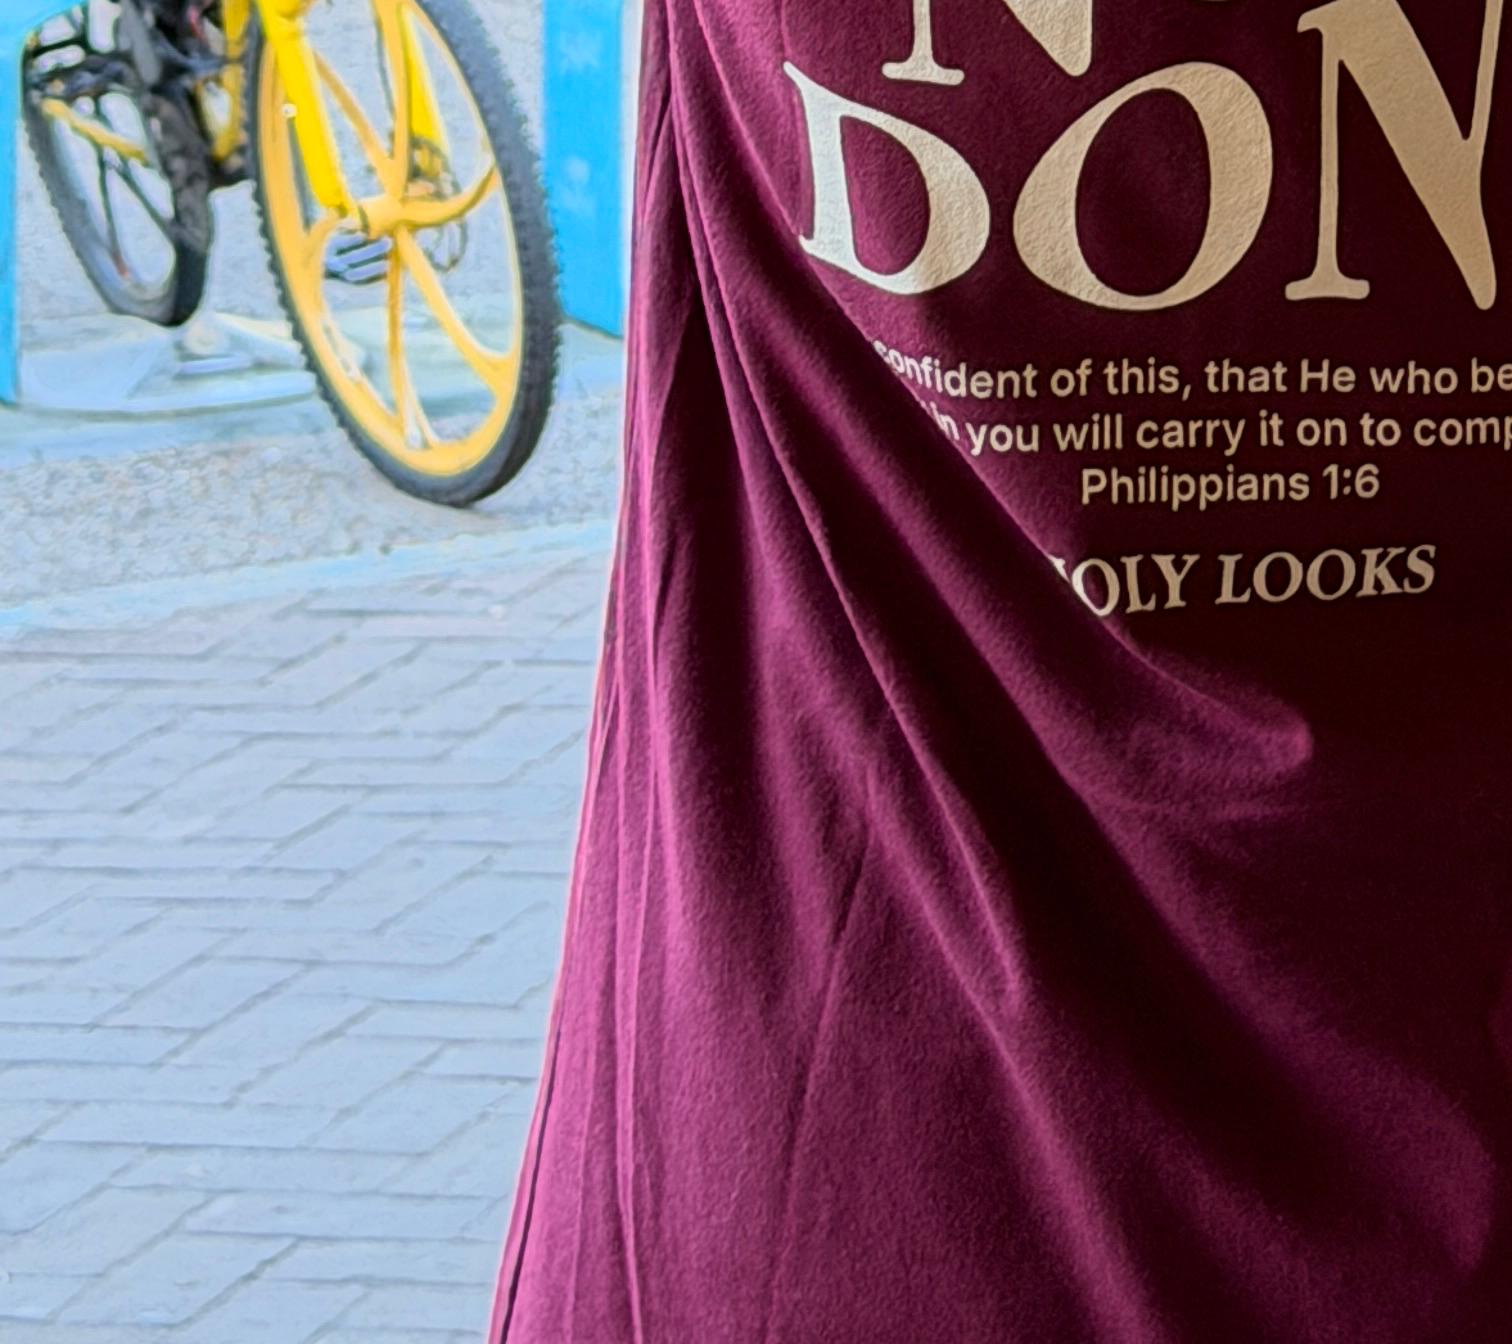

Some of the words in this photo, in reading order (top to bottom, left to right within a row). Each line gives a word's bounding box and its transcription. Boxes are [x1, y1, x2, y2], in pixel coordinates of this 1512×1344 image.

[1050, 358, 1092, 397] of
[1104, 357, 1192, 401] this,
[1205, 359, 1287, 393] that
[1301, 359, 1356, 392] He
[1370, 361, 1458, 394] who
[965, 422, 1039, 457] you
[1053, 414, 1122, 451] will
[1136, 420, 1245, 456] carry
[1260, 410, 1283, 446] it
[1297, 418, 1347, 446] on
[1360, 413, 1401, 446] to
[1082, 464, 1310, 511] Philippians
[1323, 464, 1379, 499] 1:6
[1046, 553, 1199, 617] OLY
[1216, 545, 1435, 603] LOOKS
